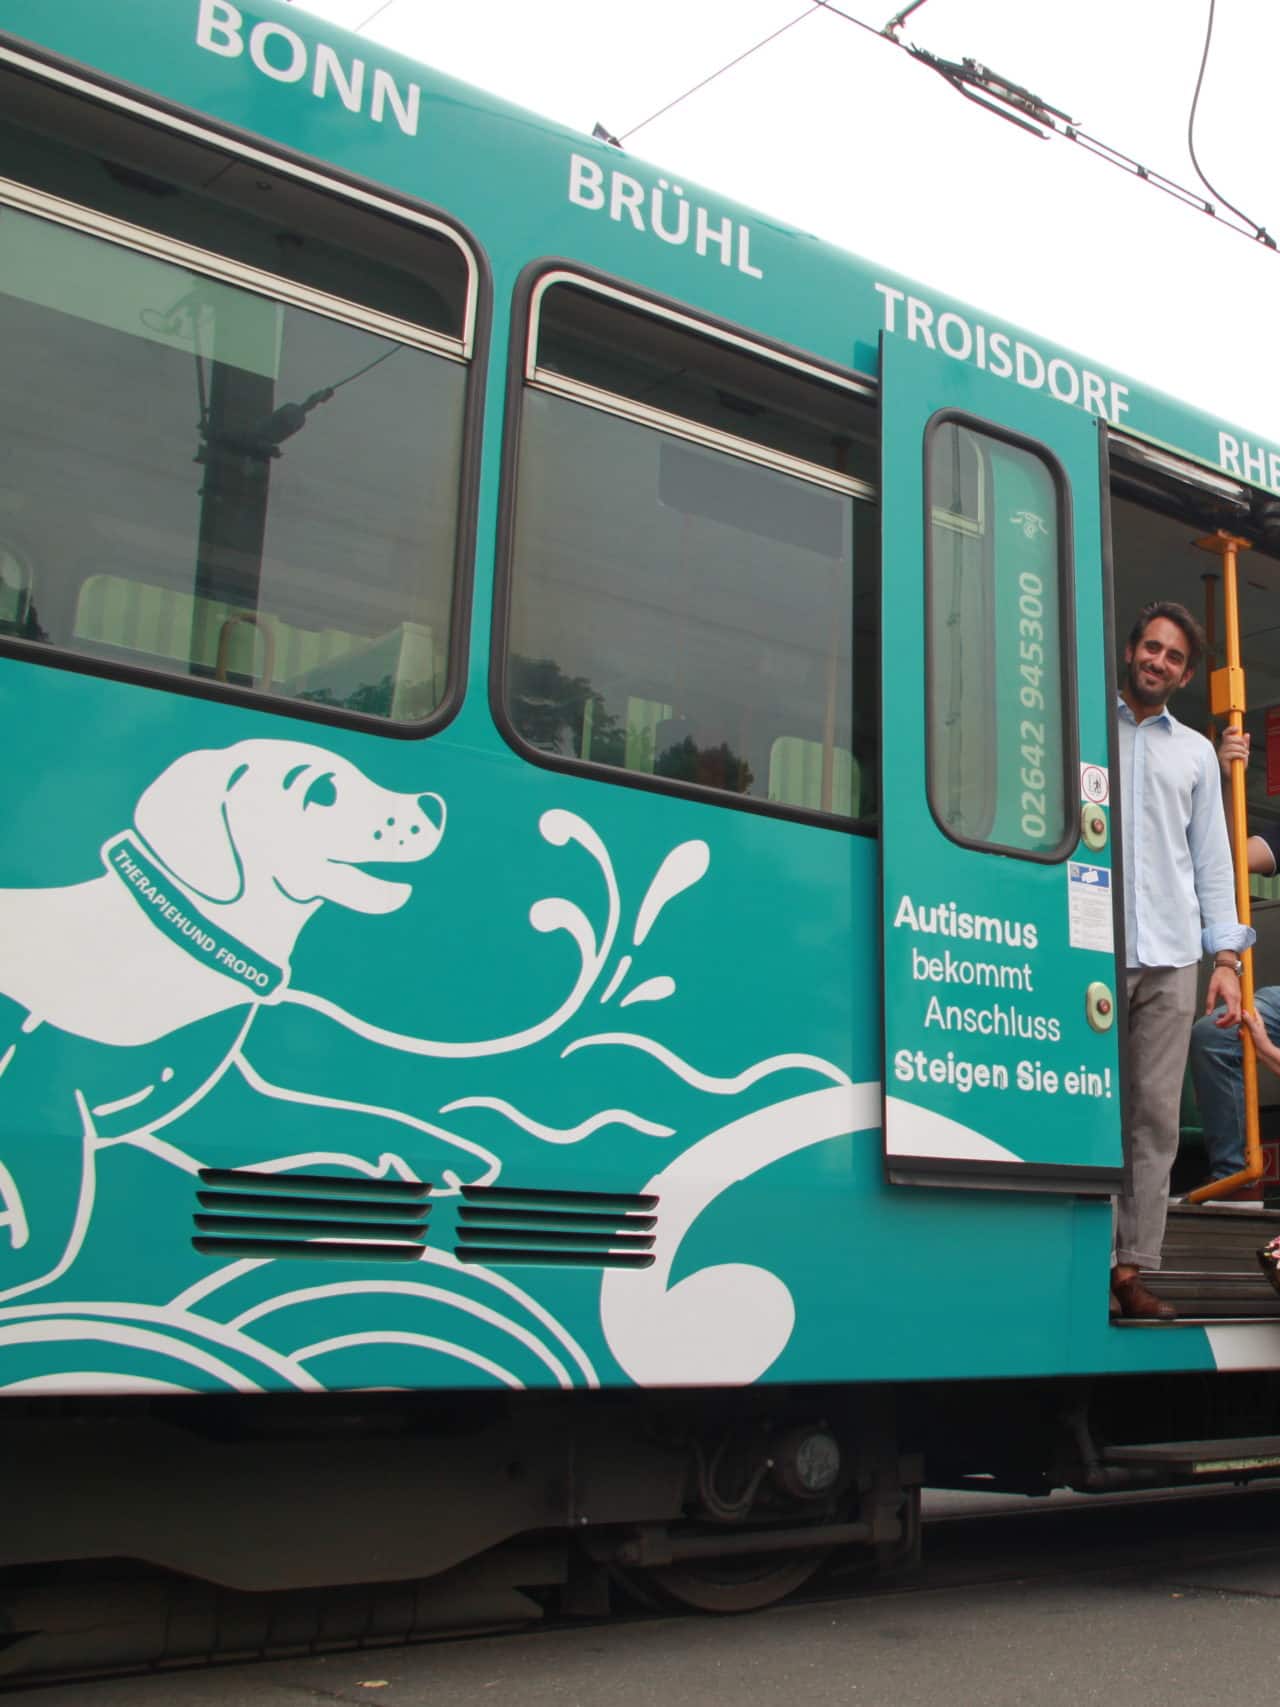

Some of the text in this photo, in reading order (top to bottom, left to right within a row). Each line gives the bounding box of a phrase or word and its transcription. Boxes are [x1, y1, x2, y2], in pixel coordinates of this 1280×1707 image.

[196, 0, 420, 137] BONN
[568, 154, 763, 279] BRÜHL
[875, 282, 1129, 424] TROISDORF
[1019, 571, 1047, 839] 02642 945300
[114, 849, 269, 987] THERAPIEHUND FRODO
[894, 895, 1038, 949] Autismus
[912, 948, 1033, 992] bekommt
[894, 1049, 1112, 1098] Steigen Sie ein!
[924, 996, 1061, 1042] Anschluss
